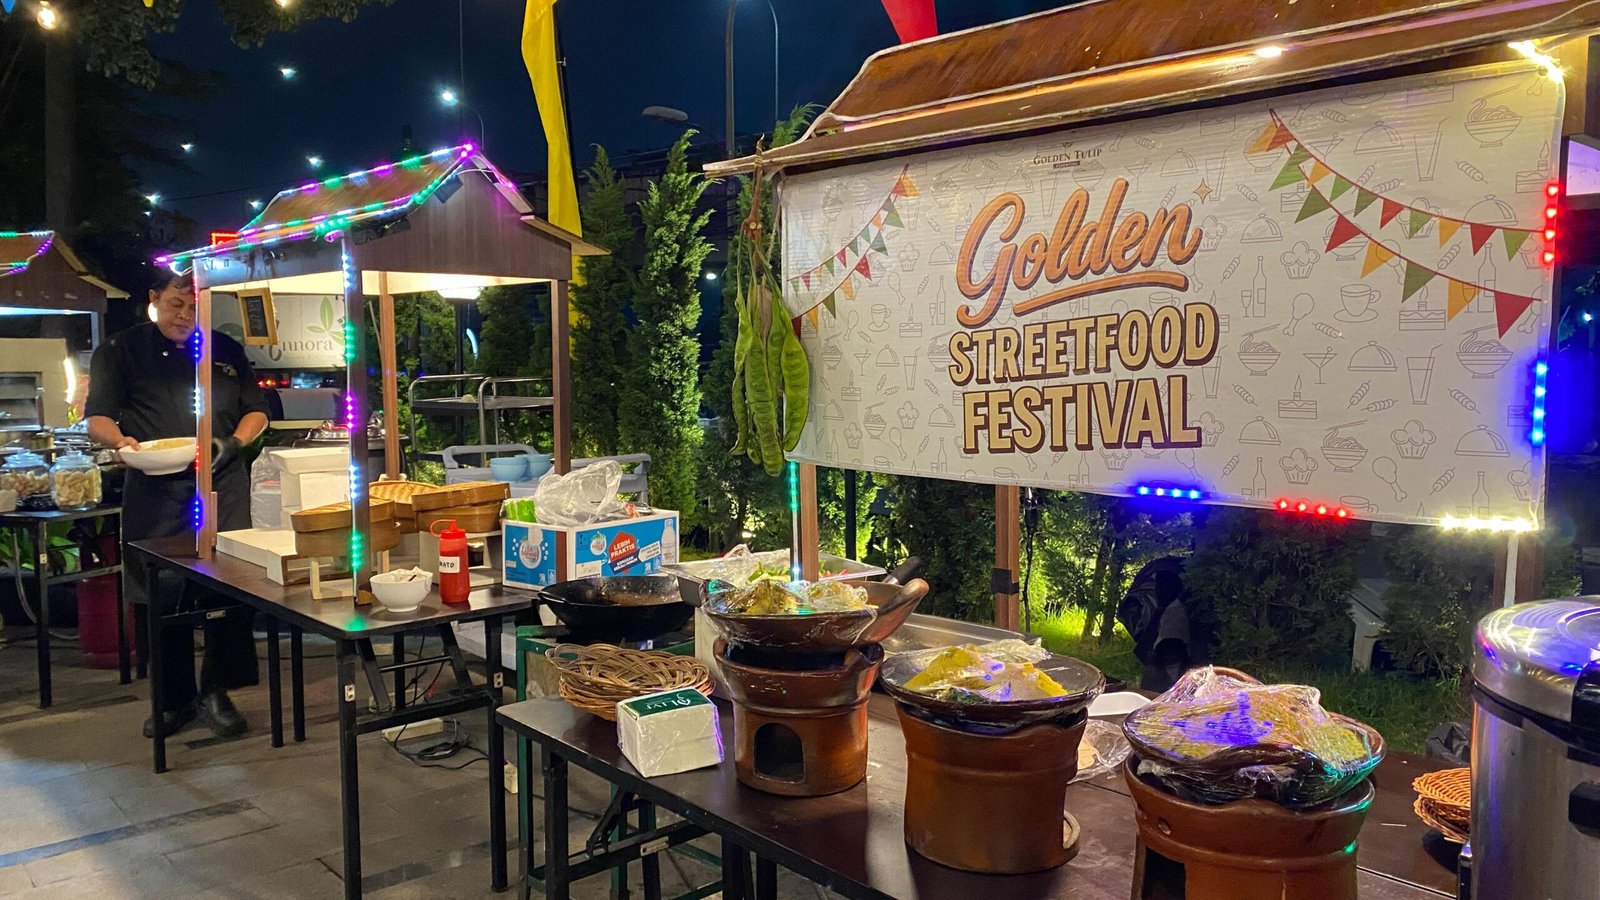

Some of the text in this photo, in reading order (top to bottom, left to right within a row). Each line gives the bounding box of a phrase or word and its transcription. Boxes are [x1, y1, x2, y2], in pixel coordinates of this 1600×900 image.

[1033, 148, 1102, 165] GOLDEN TULIP
[956, 177, 1203, 329] Golden
[268, 340, 334, 361] nnora
[949, 302, 1219, 386] STREETFOOD
[963, 374, 1202, 454] FESTIVAL
[610, 543, 635, 558] PRAKTIS
[613, 539, 631, 551] LEBIH
